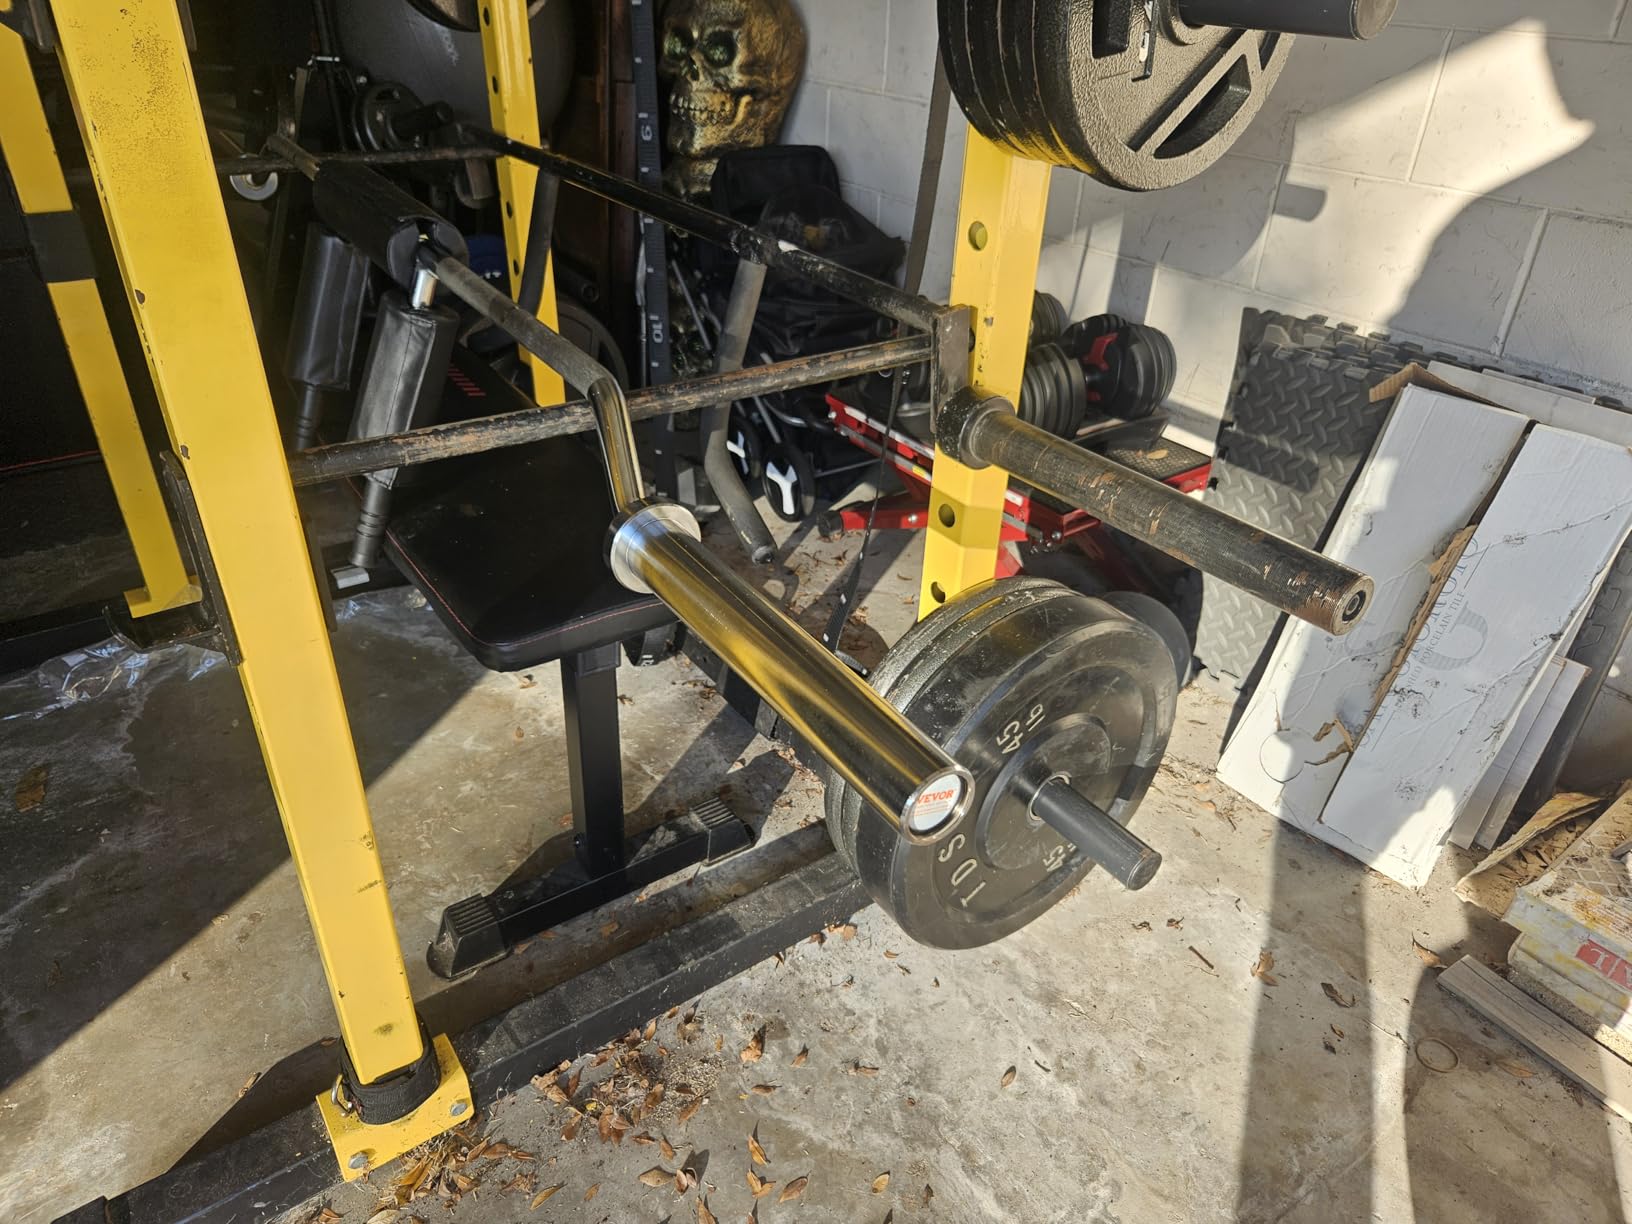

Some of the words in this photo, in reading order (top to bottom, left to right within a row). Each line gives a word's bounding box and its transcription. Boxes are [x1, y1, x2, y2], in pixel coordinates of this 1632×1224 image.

[652, 322, 664, 343] 10
[1419, 612, 1453, 665] PORCELAIN
[1449, 591, 1465, 611] TILE
[996, 720, 1025, 755] 45
